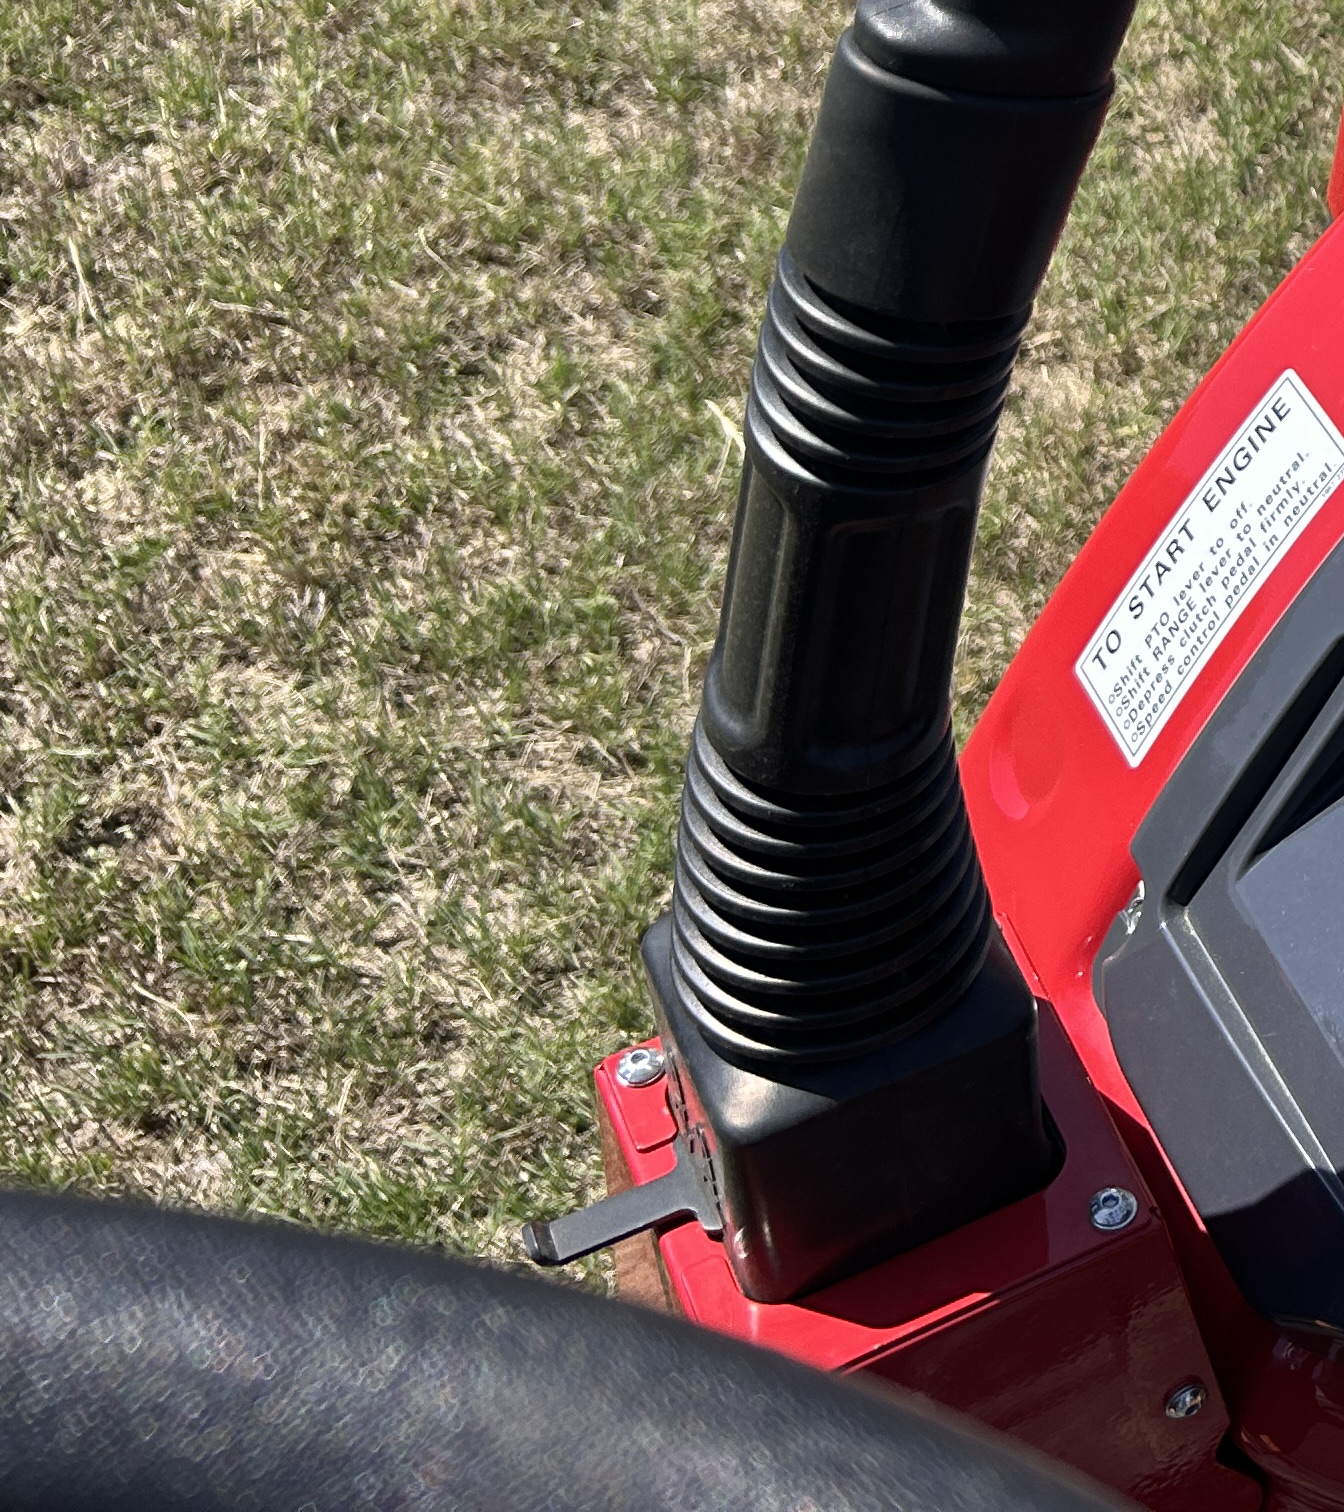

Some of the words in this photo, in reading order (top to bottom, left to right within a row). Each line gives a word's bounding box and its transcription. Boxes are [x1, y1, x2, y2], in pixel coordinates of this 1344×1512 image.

[1091, 628, 1121, 670] TO
[1128, 518, 1193, 619] START
[1202, 396, 1290, 512] ENGINE
[1112, 654, 1142, 697] Shift
[1144, 611, 1169, 649] PTO
[1172, 561, 1204, 606] lever
[1208, 537, 1224, 555] to
[1229, 501, 1253, 530] off.
[1119, 666, 1150, 710] Shift
[1152, 596, 1196, 661] RANGE
[1198, 548, 1231, 593] lever
[1235, 523, 1251, 542] to
[1256, 452, 1309, 516] neutral.
[1127, 654, 1176, 723] Depress
[1179, 595, 1216, 647] clutch
[1220, 536, 1256, 590] pedal
[1258, 479, 1306, 534] firmly.
[1135, 680, 1174, 738] Speed
[1176, 610, 1225, 675] control
[1224, 555, 1264, 609] pedal
[1262, 533, 1279, 552] in
[1283, 462, 1337, 527] neutral.
